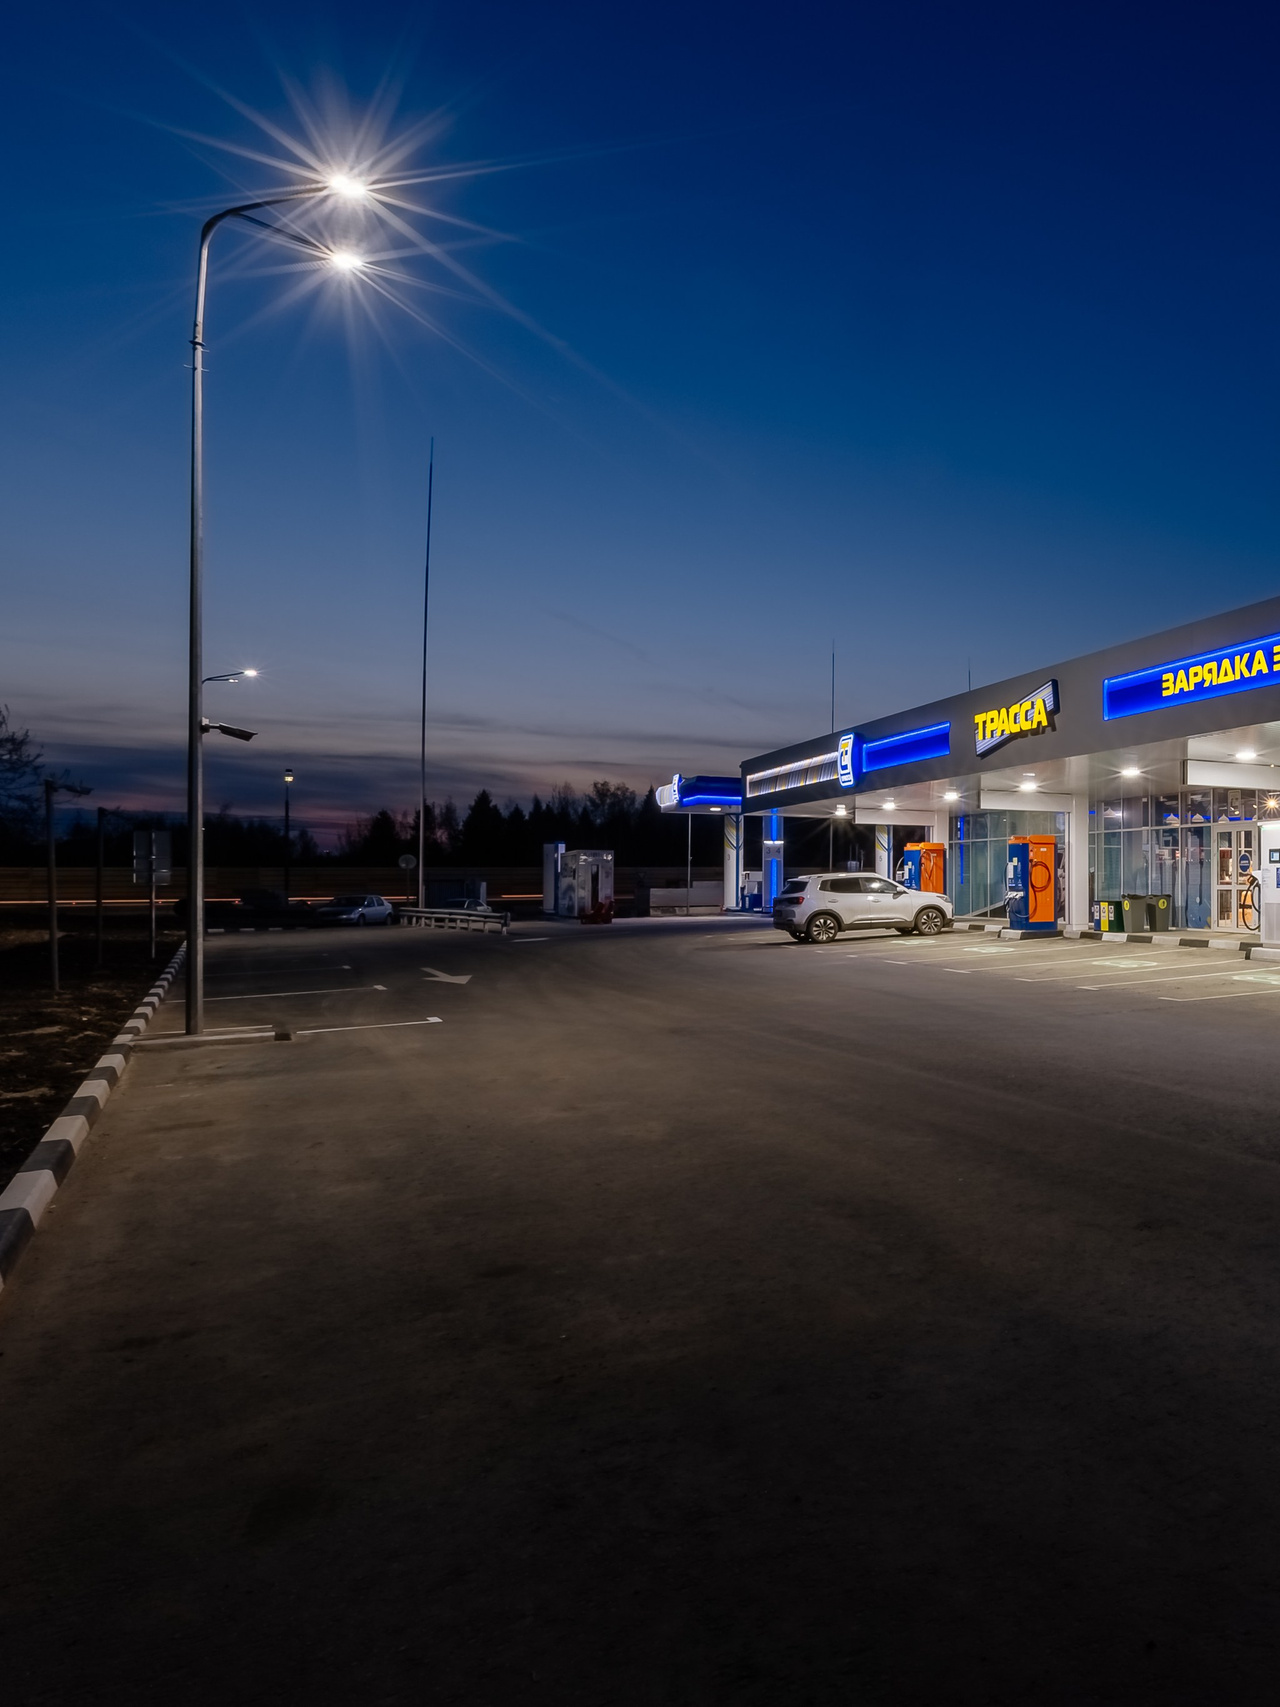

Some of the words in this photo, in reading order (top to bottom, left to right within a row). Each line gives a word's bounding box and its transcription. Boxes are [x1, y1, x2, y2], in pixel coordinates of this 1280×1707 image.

[1162, 650, 1268, 697] ЗАРЯДКА
[974, 698, 1048, 741] ТРАССА
[766, 846, 771, 854] 3
